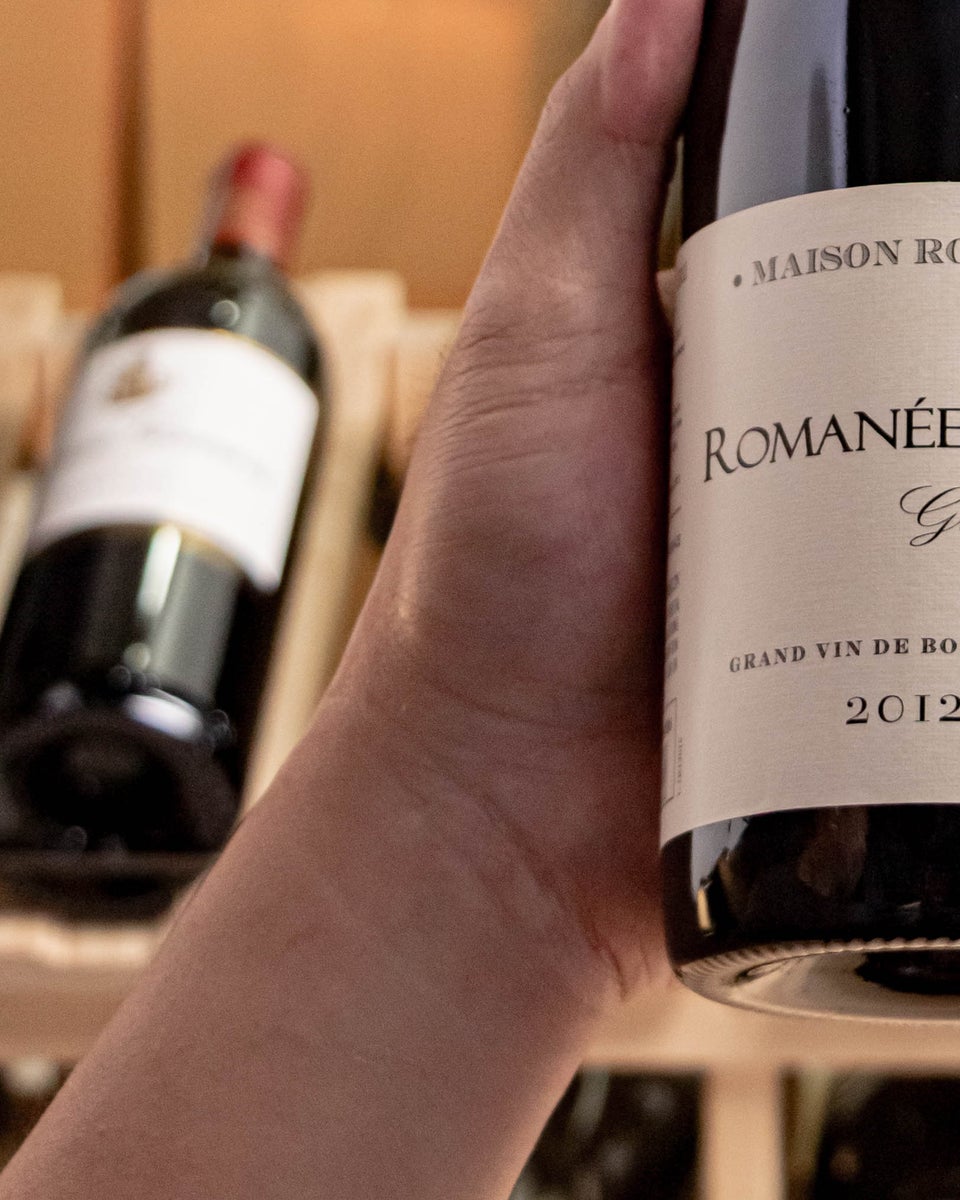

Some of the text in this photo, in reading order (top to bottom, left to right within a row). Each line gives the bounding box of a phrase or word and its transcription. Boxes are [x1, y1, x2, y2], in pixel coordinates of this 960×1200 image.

[751, 238, 902, 286] MAISON
[729, 645, 806, 673] GRAND
[816, 639, 863, 660] VIN
[873, 637, 910, 656] DE
